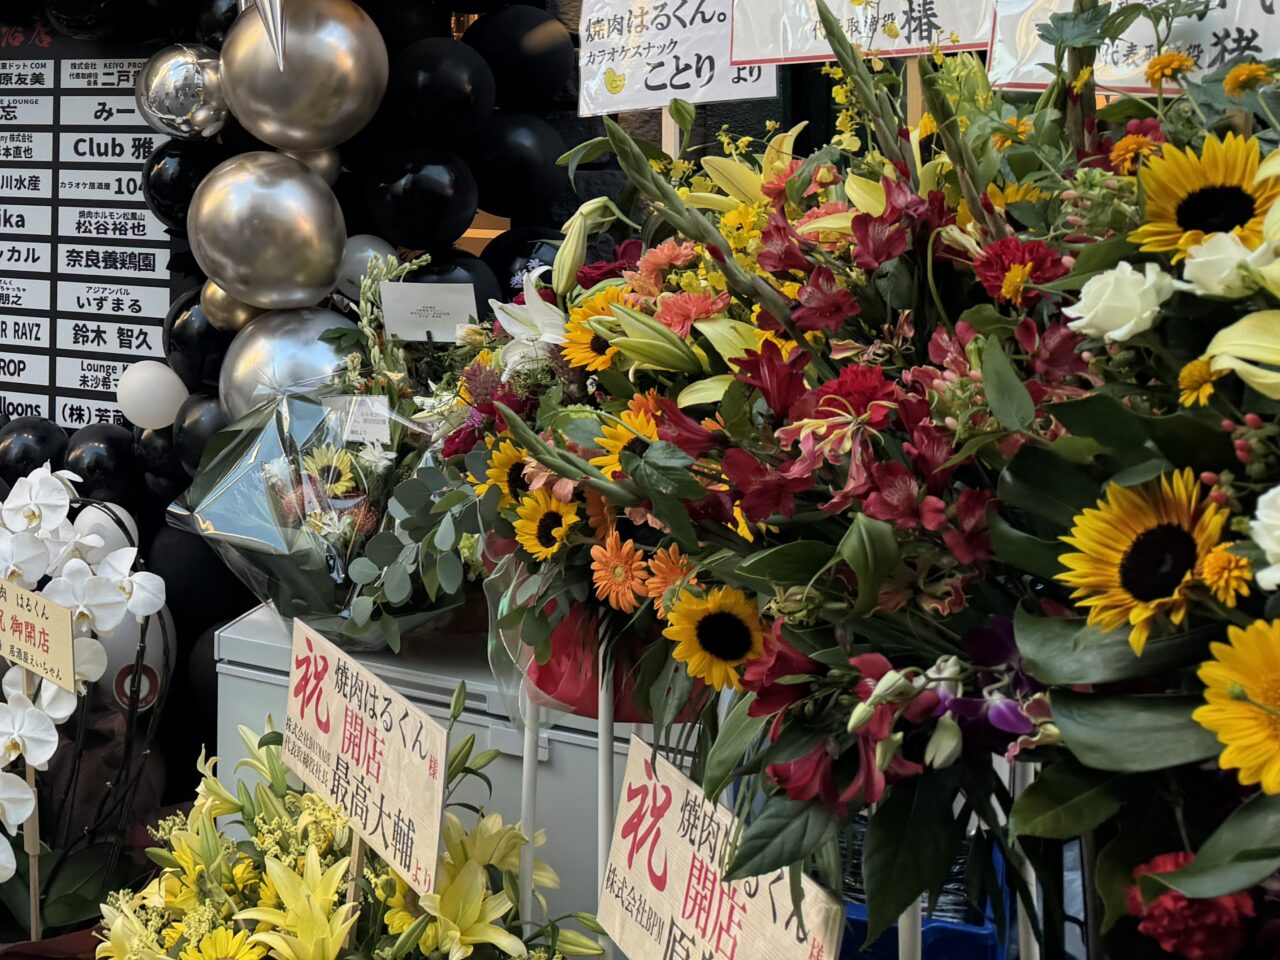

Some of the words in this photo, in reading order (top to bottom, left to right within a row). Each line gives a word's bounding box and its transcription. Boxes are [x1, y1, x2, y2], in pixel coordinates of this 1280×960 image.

[30, 62, 46, 70] COM
[71, 62, 96, 70] 株式会社
[587, 39, 678, 66] カラオケスナック
[645, 53, 715, 90] ことり
[9, 134, 32, 142] 株式会社
[74, 138, 124, 157] Club
[60, 182, 110, 190] カラオケ居酒屋
[75, 220, 146, 236] 松谷裕也
[66, 249, 155, 272] 奈良養鶏園
[86, 286, 130, 296] アジアンバル
[77, 296, 142, 314] いずまる
[14, 322, 41, 341] RAYZ
[73, 323, 107, 347] 鈴木
[117, 328, 152, 351] 智久
[81, 361, 117, 377] Lounge
[17, 593, 49, 620] はるくん
[10, 614, 50, 654] 御開店
[294, 637, 330, 735] 祝
[334, 657, 428, 760] 焼肉はるくん
[428, 754, 439, 780] 様
[342, 704, 386, 784] 開店
[330, 754, 416, 873] 最高大輔
[621, 758, 672, 892] 祝
[412, 858, 431, 893] より
[681, 852, 747, 960] 開店
